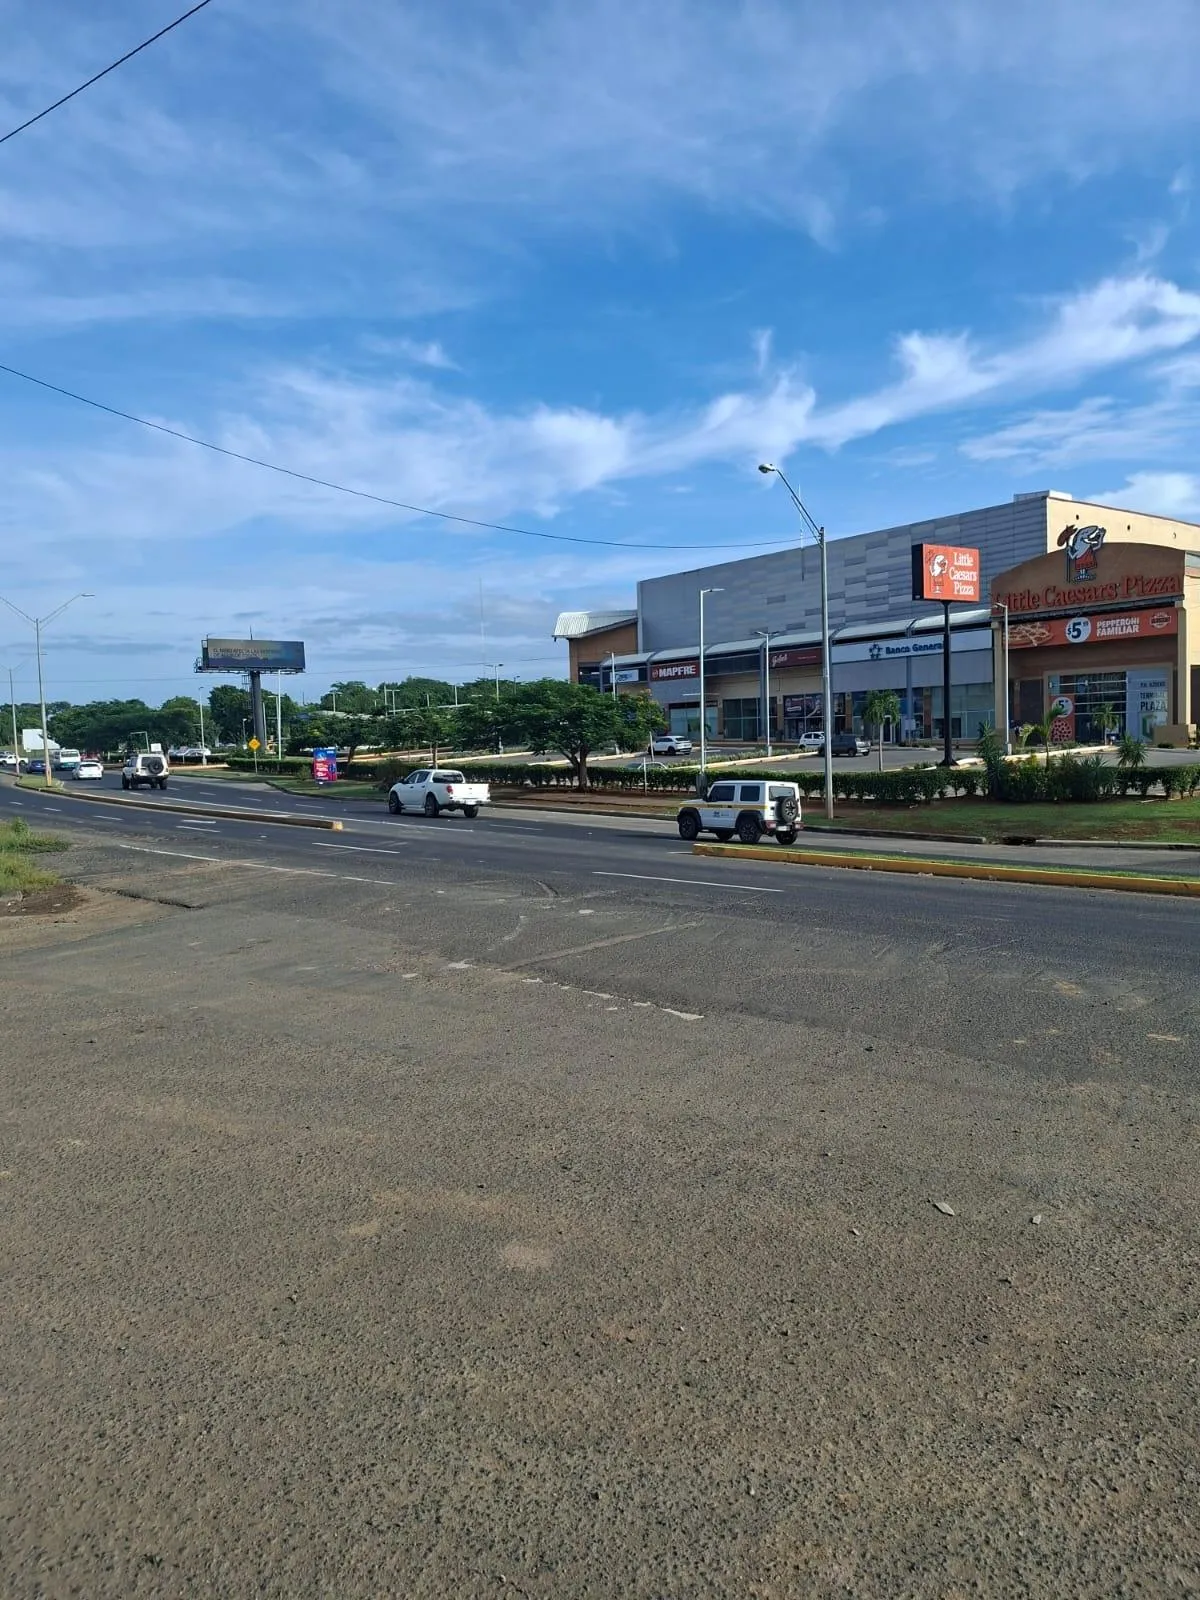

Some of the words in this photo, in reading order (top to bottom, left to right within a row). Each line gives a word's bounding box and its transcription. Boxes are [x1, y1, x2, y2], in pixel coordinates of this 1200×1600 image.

[953, 551, 974, 567] Little
[949, 566, 978, 582] Caesars
[953, 581, 975, 596] Pizza
[1121, 574, 1180, 598] Pizza
[1096, 616, 1140, 629] PEPPERONI
[1096, 623, 1140, 637] FAMILIAR
[885, 645, 911, 655] Banco
[912, 642, 943, 652] Genera
[658, 665, 697, 678] MAPFRE
[1140, 701, 1167, 711] PLAZA
